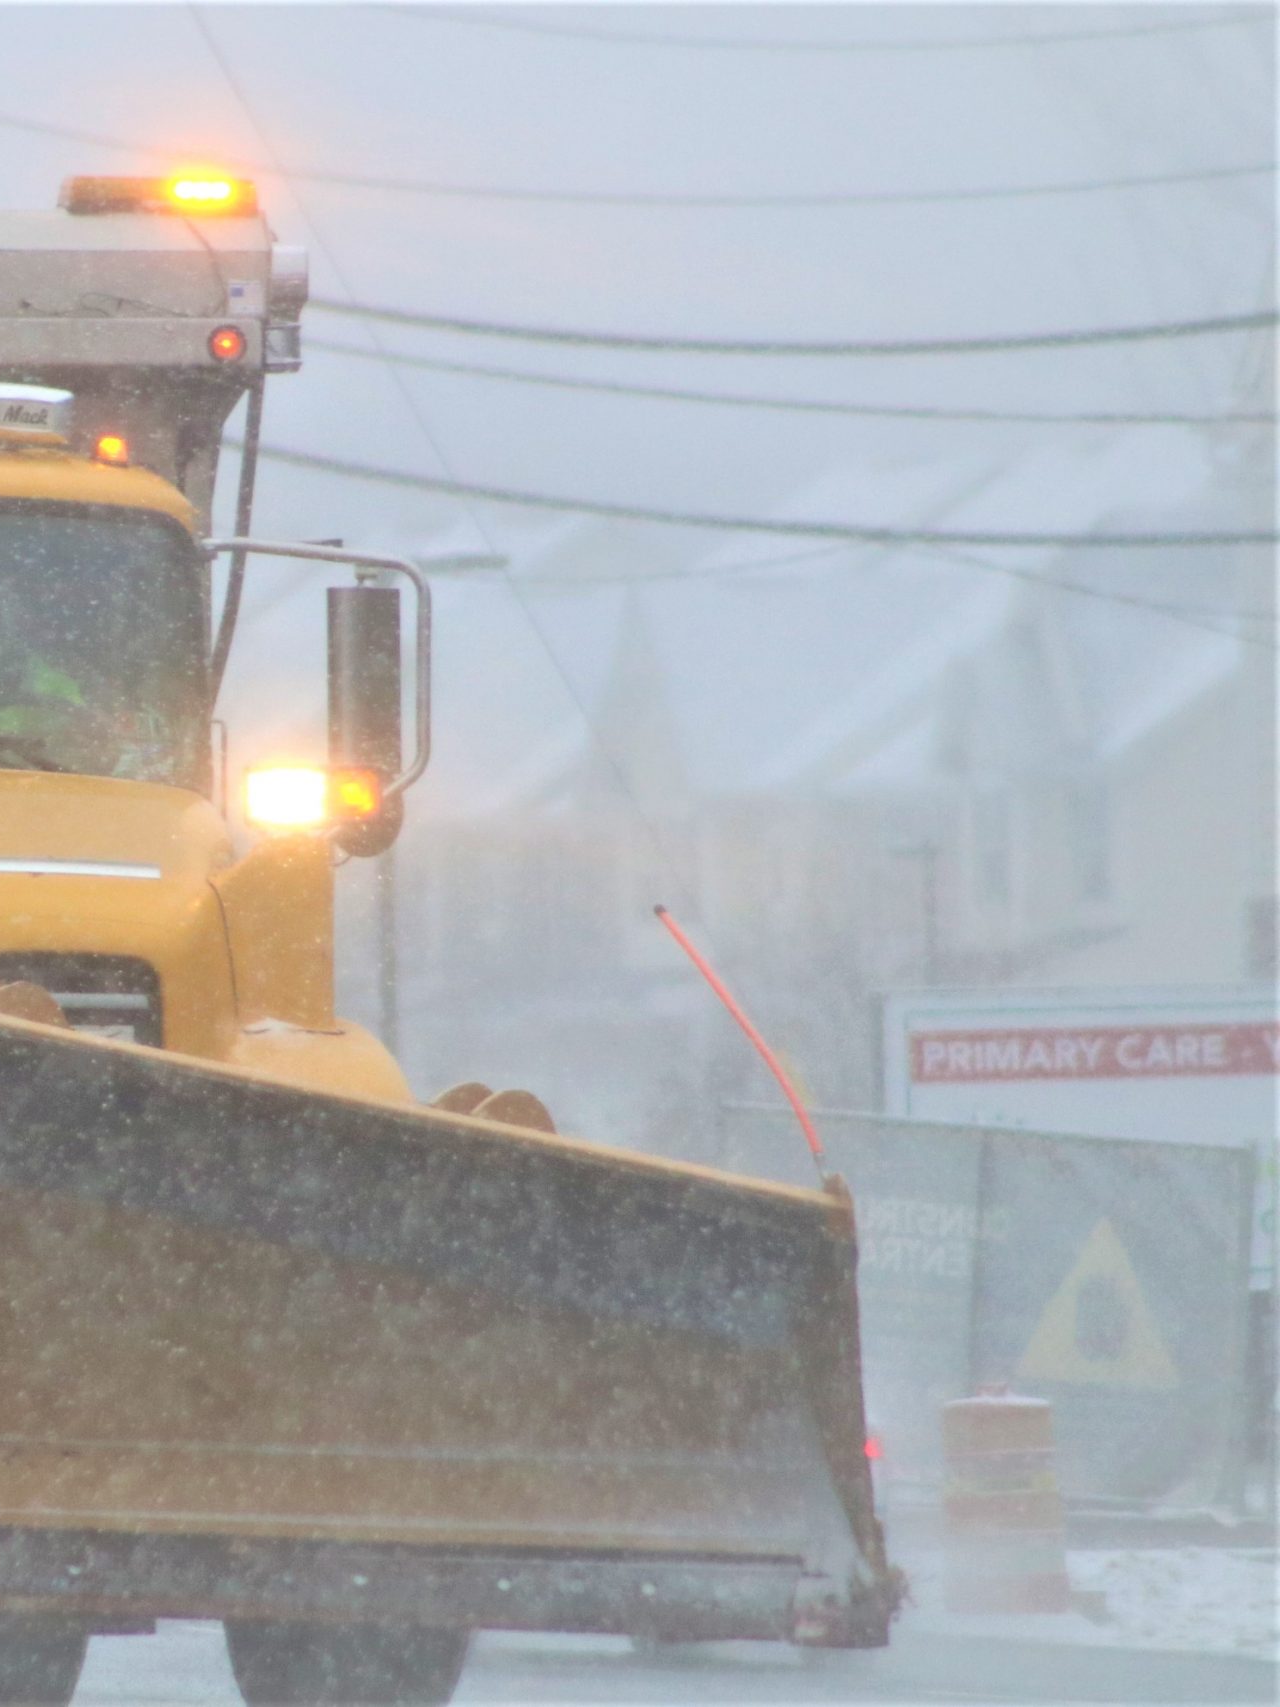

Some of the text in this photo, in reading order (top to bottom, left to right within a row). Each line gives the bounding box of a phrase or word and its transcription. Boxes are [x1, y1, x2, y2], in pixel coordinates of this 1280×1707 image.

[3, 405, 48, 425] Mack
[922, 1038, 1104, 1073] PRIMARY
[1116, 1033, 1227, 1068] CARE
